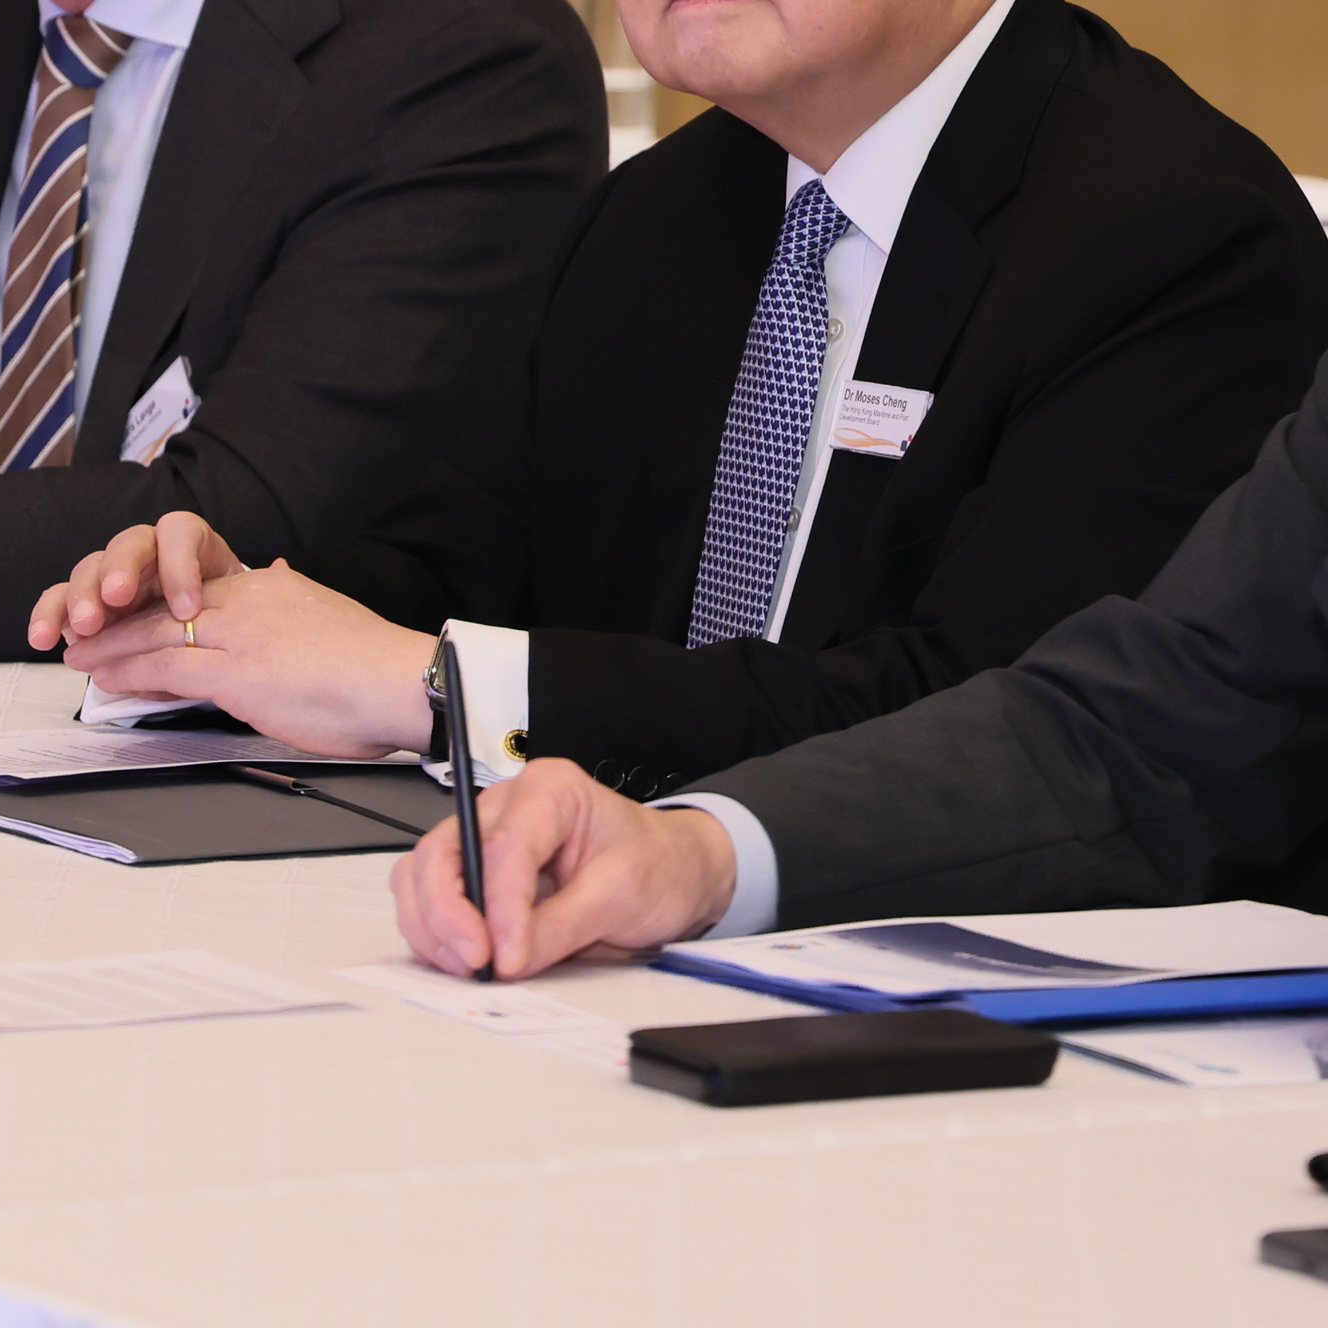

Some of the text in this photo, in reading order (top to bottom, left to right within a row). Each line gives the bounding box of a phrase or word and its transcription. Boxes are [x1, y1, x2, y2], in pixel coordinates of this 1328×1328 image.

[844, 389, 908, 412] Dr Moses Cheng
